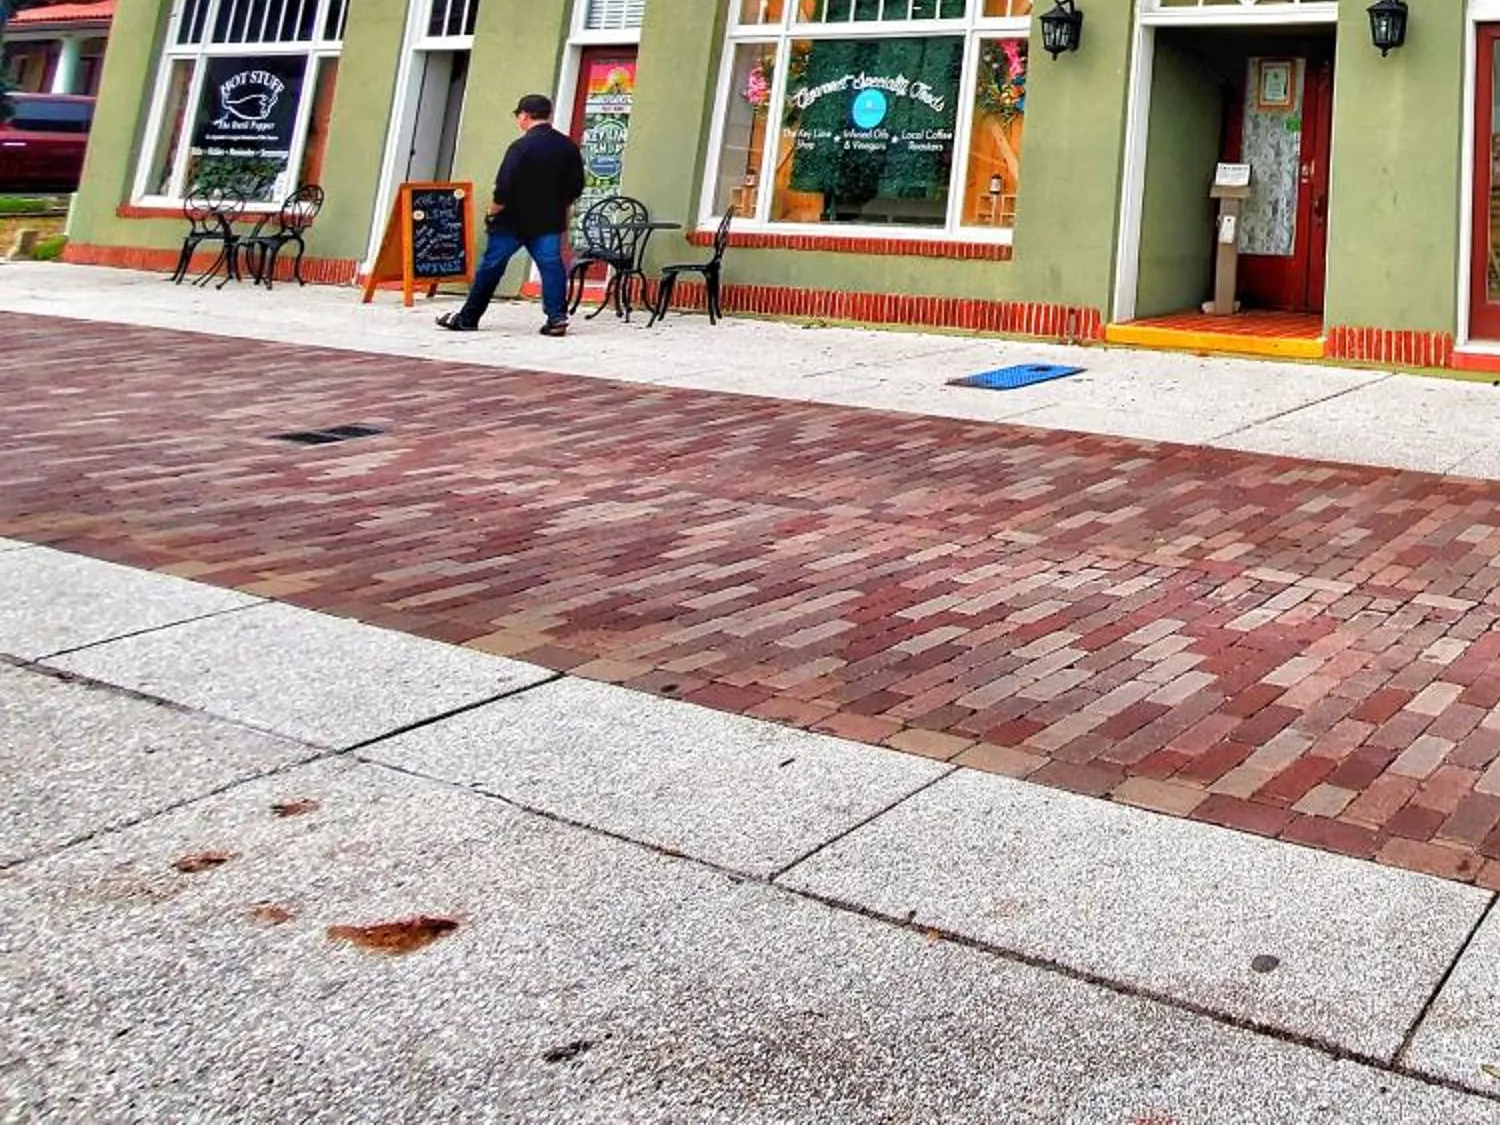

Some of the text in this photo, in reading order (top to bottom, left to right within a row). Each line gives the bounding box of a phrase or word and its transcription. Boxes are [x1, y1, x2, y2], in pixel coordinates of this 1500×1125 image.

[221, 70, 285, 93] HOT STUFF
[901, 129, 924, 140] Local
